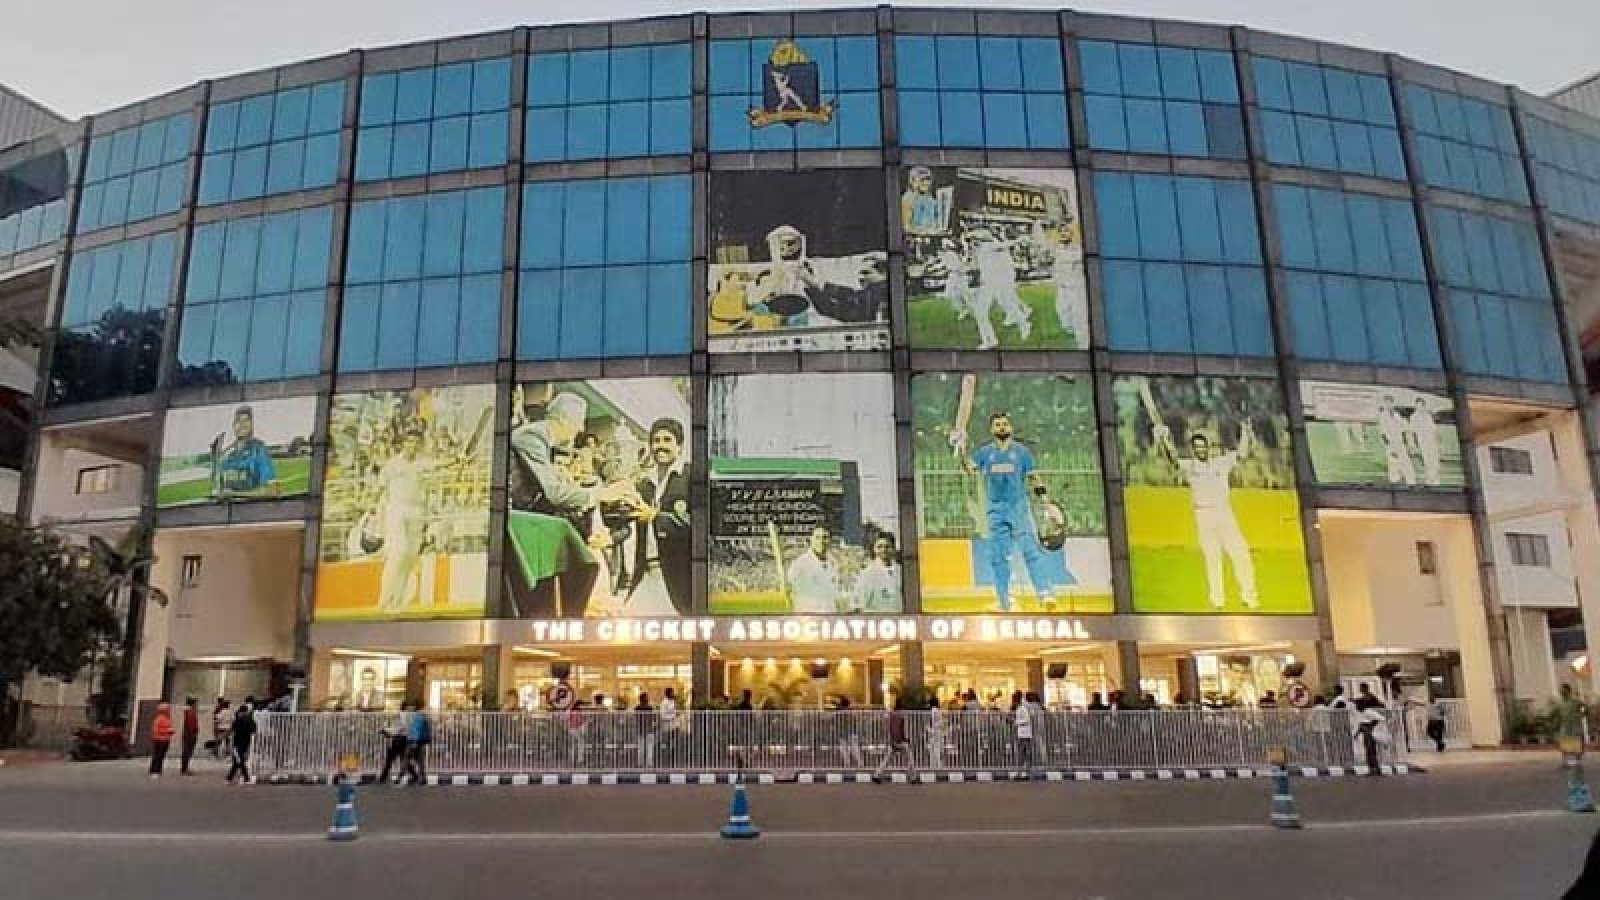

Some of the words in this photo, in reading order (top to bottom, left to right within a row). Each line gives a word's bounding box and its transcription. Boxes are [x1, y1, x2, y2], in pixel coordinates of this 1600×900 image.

[988, 190, 1044, 208] INDIA
[532, 620, 584, 640] THE
[597, 620, 714, 640] CRICKET
[730, 620, 916, 640] ASSOCIATION
[932, 619, 964, 639] OF
[981, 619, 1089, 639] BENGAL
